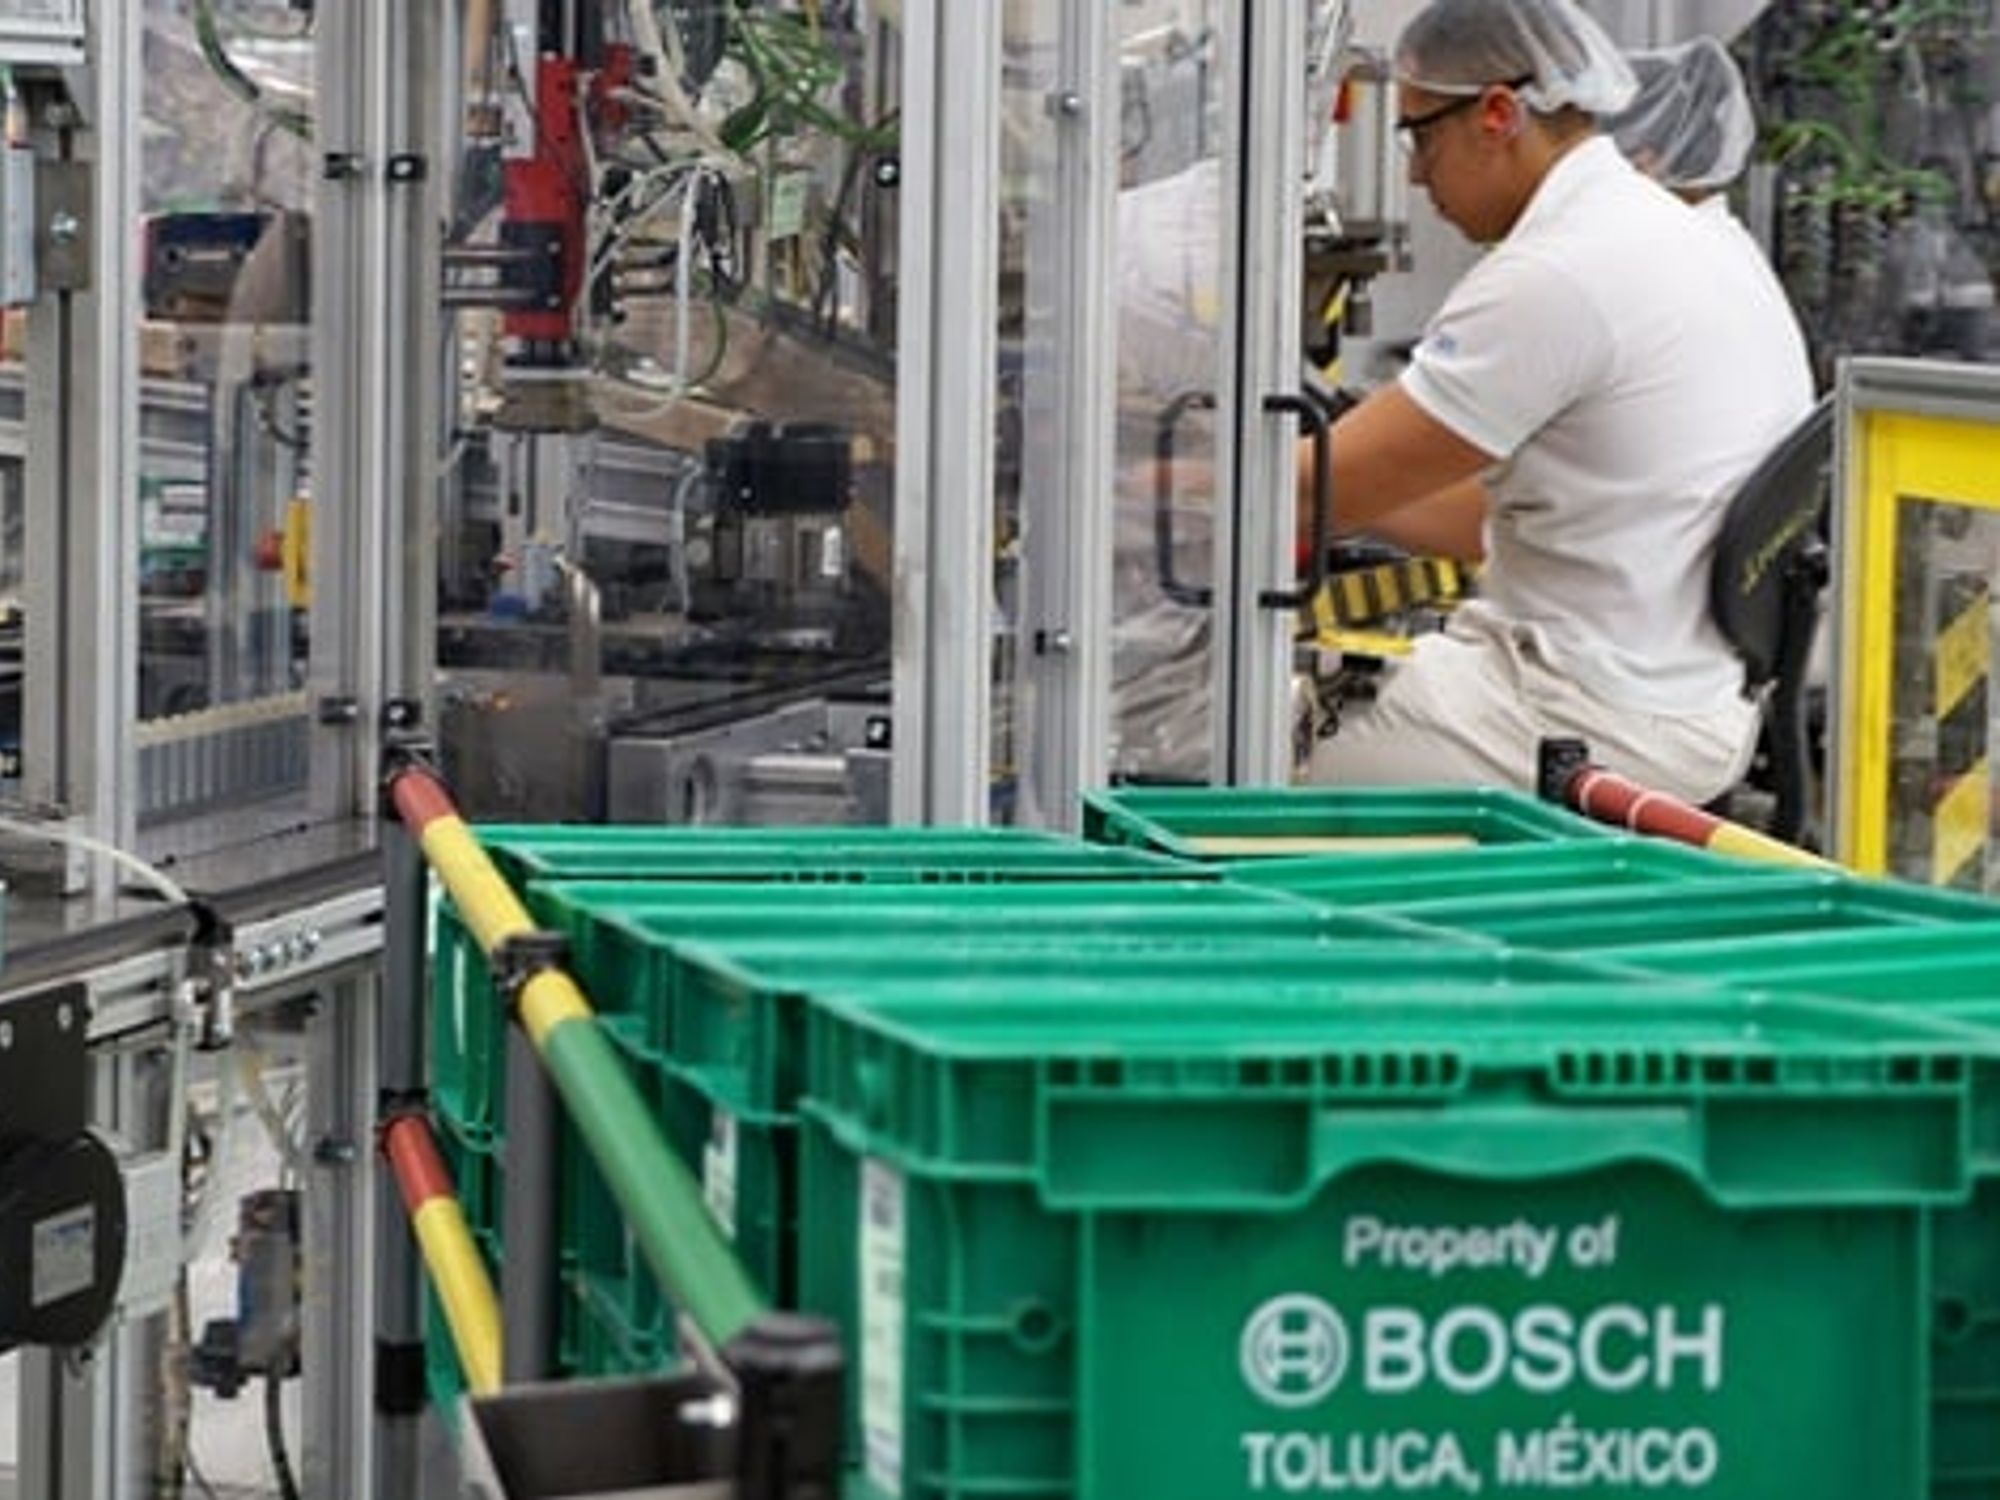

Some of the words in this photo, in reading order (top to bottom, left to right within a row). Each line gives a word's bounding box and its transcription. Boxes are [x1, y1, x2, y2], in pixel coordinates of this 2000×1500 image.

[1344, 1216, 1556, 1276] Property
[1566, 1215, 1619, 1266] of
[1364, 1304, 1724, 1392] BOSCH
[1240, 1430, 1481, 1493] TOLUCA,
[1498, 1413, 1718, 1486] MÉXICO
